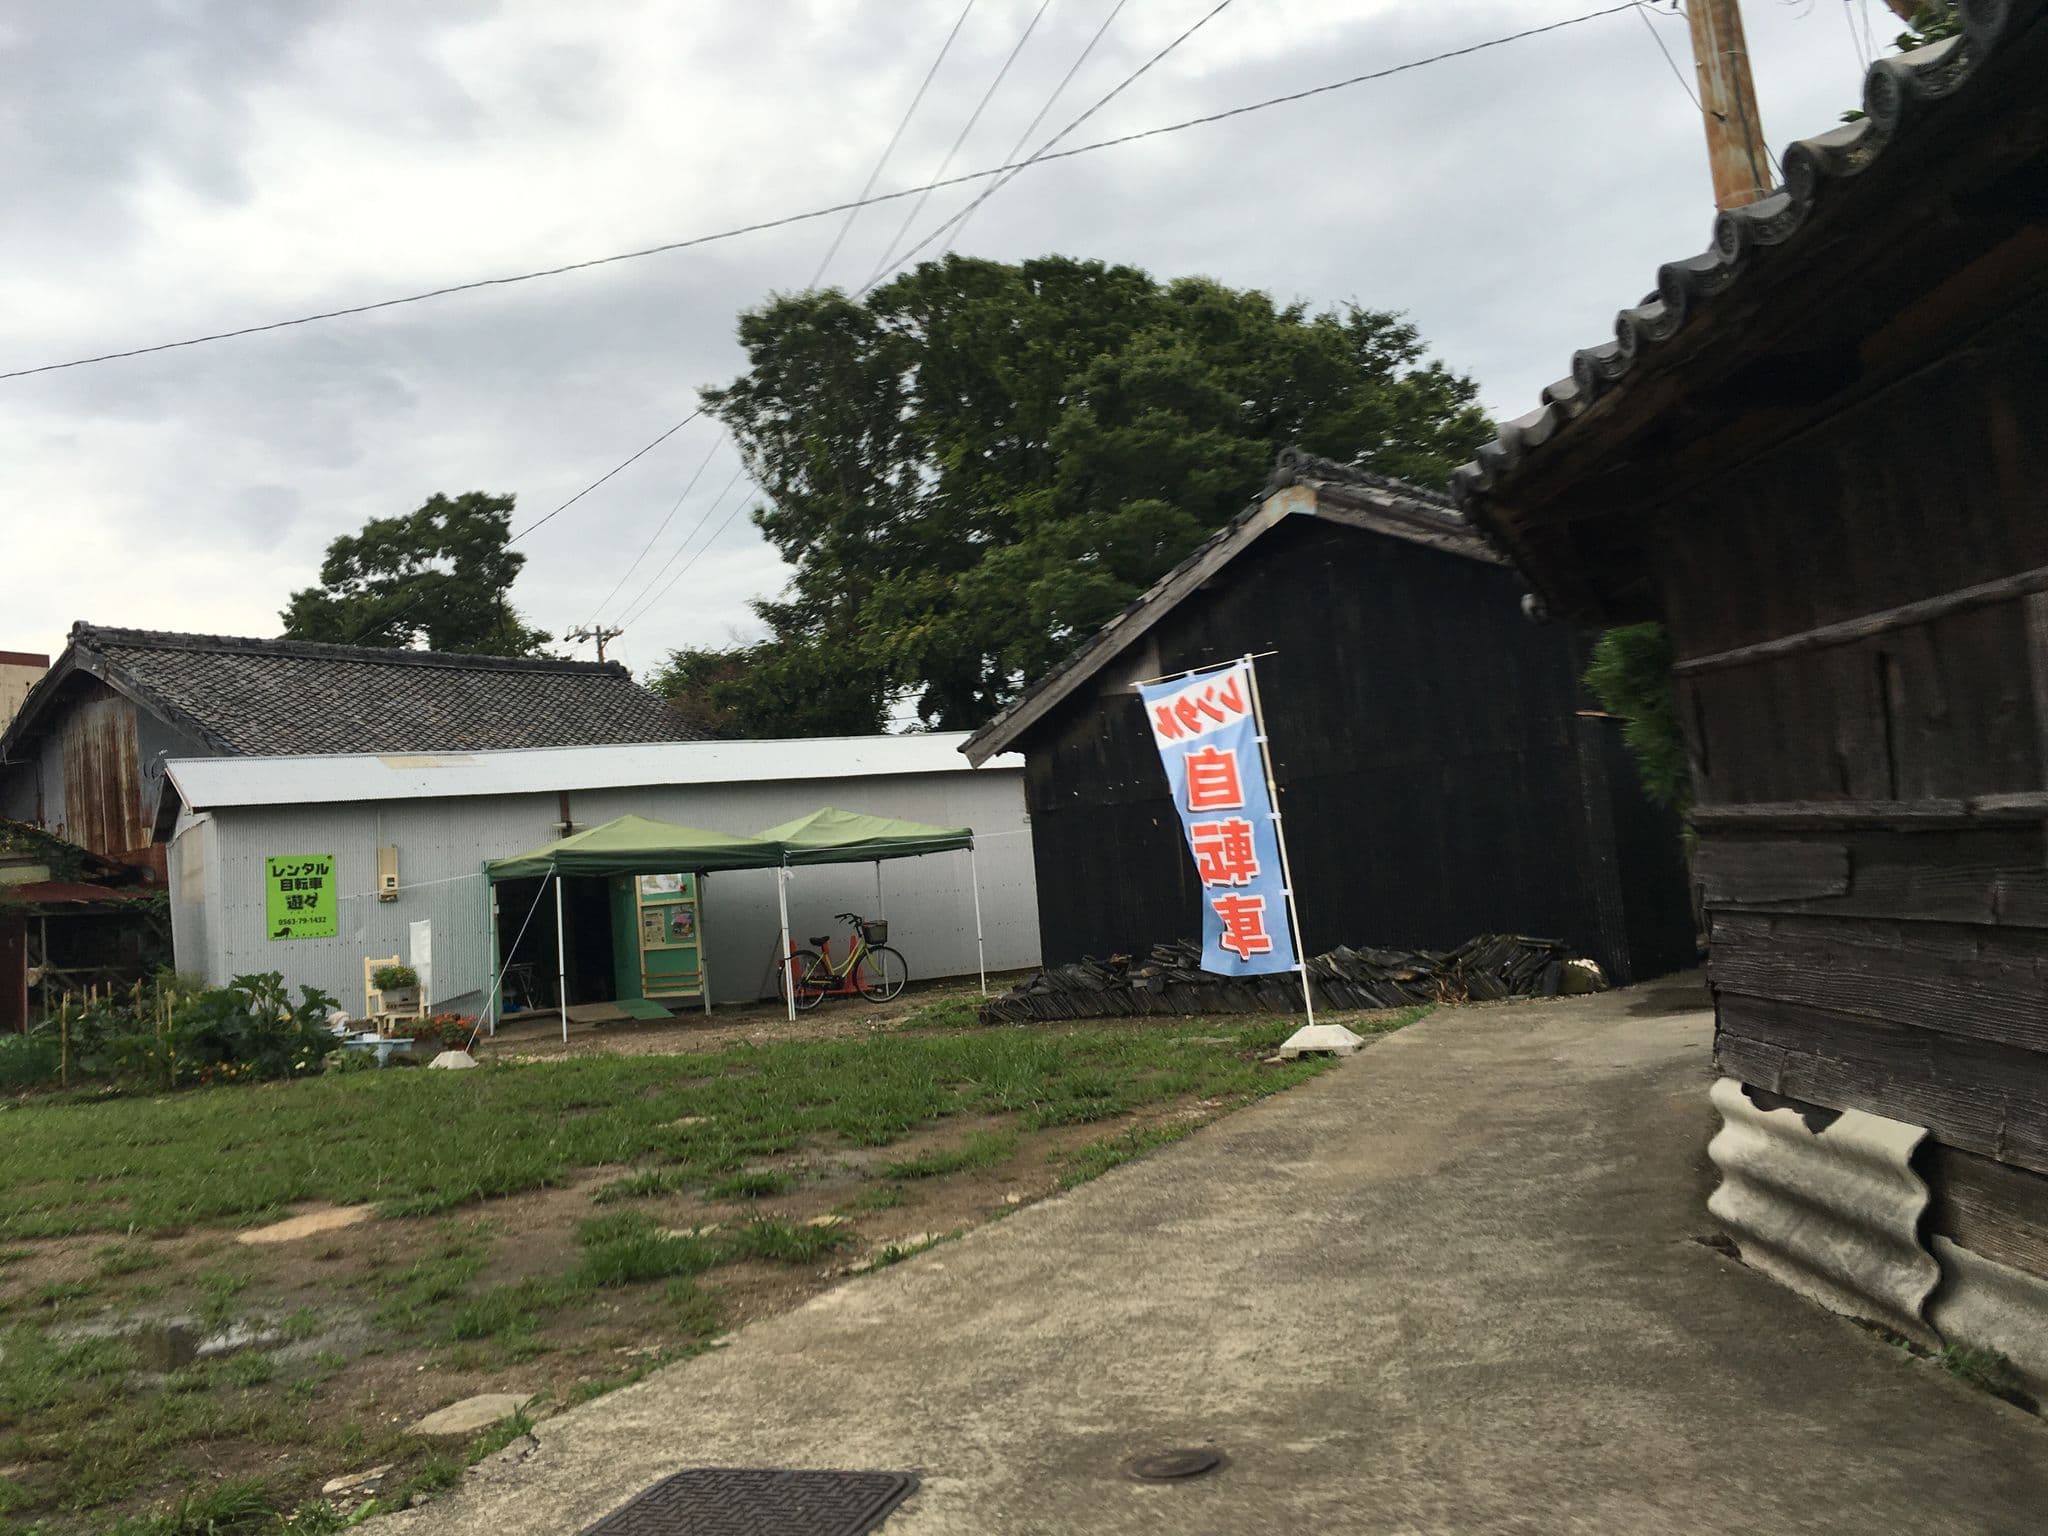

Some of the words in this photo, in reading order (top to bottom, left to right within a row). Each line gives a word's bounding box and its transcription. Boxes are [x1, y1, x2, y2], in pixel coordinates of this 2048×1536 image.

[272, 863, 329, 878] レンタル
[280, 877, 323, 892] 自転車
[286, 892, 319, 910] 遊々
